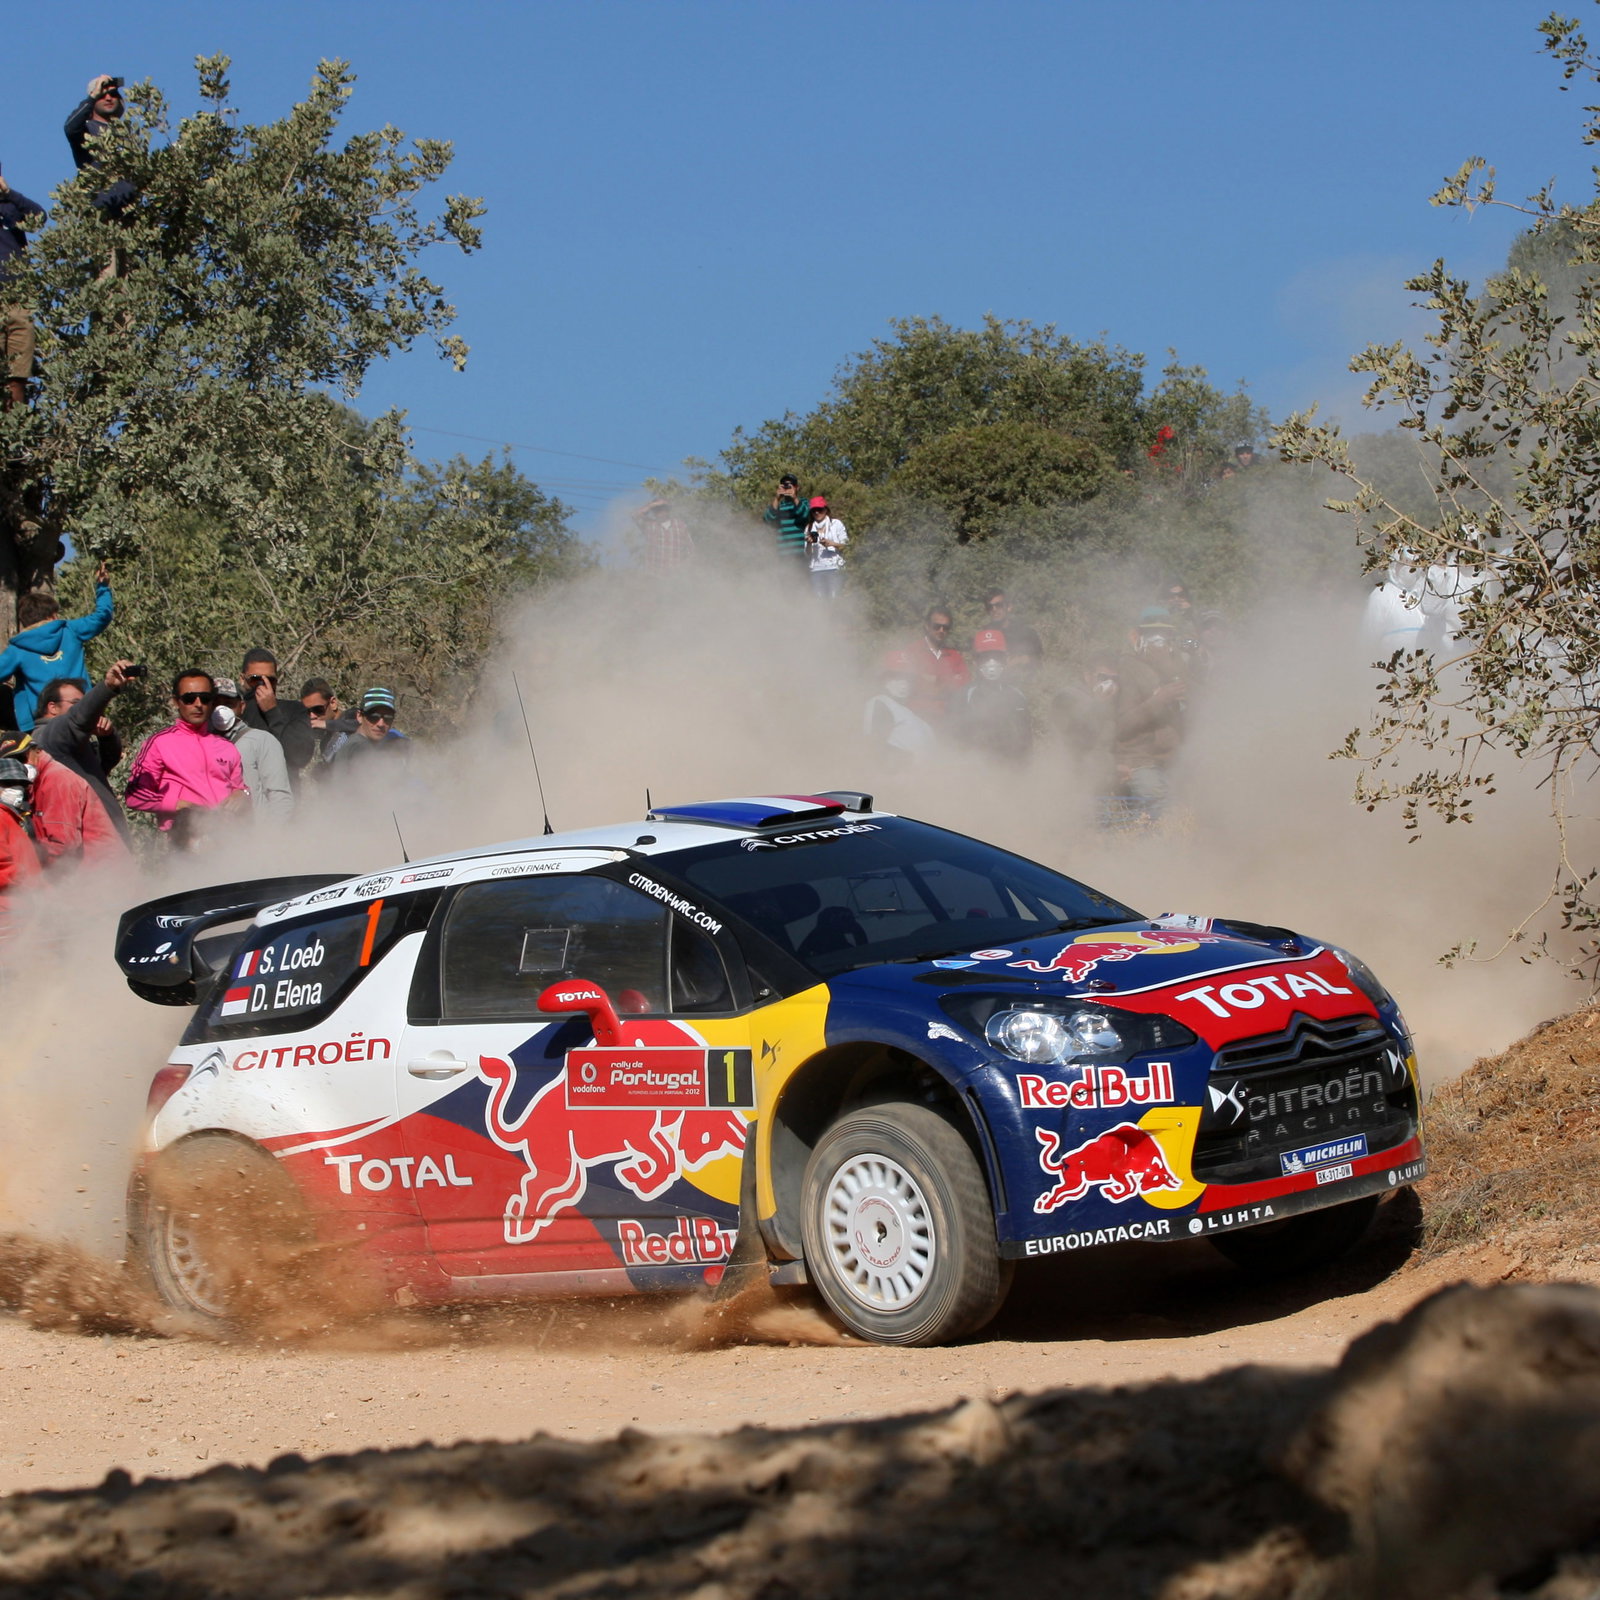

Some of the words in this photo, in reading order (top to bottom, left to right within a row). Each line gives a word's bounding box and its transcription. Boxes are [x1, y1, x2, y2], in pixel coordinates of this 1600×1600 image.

[774, 821, 882, 845] CITROËN
[628, 872, 722, 935] CITROEN-WRC.COM
[359, 899, 384, 966] 1
[259, 948, 275, 975] S.
[280, 940, 325, 971] Loeb
[251, 987, 268, 1012] D.
[274, 980, 322, 1008] Elena
[555, 991, 601, 1003] TOTAL
[1174, 971, 1352, 1018] TOTAL
[232, 1033, 391, 1072] CITROËN
[610, 1061, 631, 1069] rally
[572, 1084, 606, 1093] vodafone
[610, 1069, 701, 1089] Portugal
[723, 1051, 736, 1103] 1
[1018, 1065, 1096, 1109] Red
[1098, 1062, 1174, 1108] Bull
[1248, 1067, 1384, 1121] CITROËN
[1304, 1139, 1363, 1164] MICHELIN
[324, 1154, 473, 1194] TOTAL
[1208, 1205, 1274, 1229] LUHTA
[618, 1216, 697, 1266] Red
[691, 1216, 740, 1261] Bu
[1025, 1219, 1171, 1256] EURODATACAR
